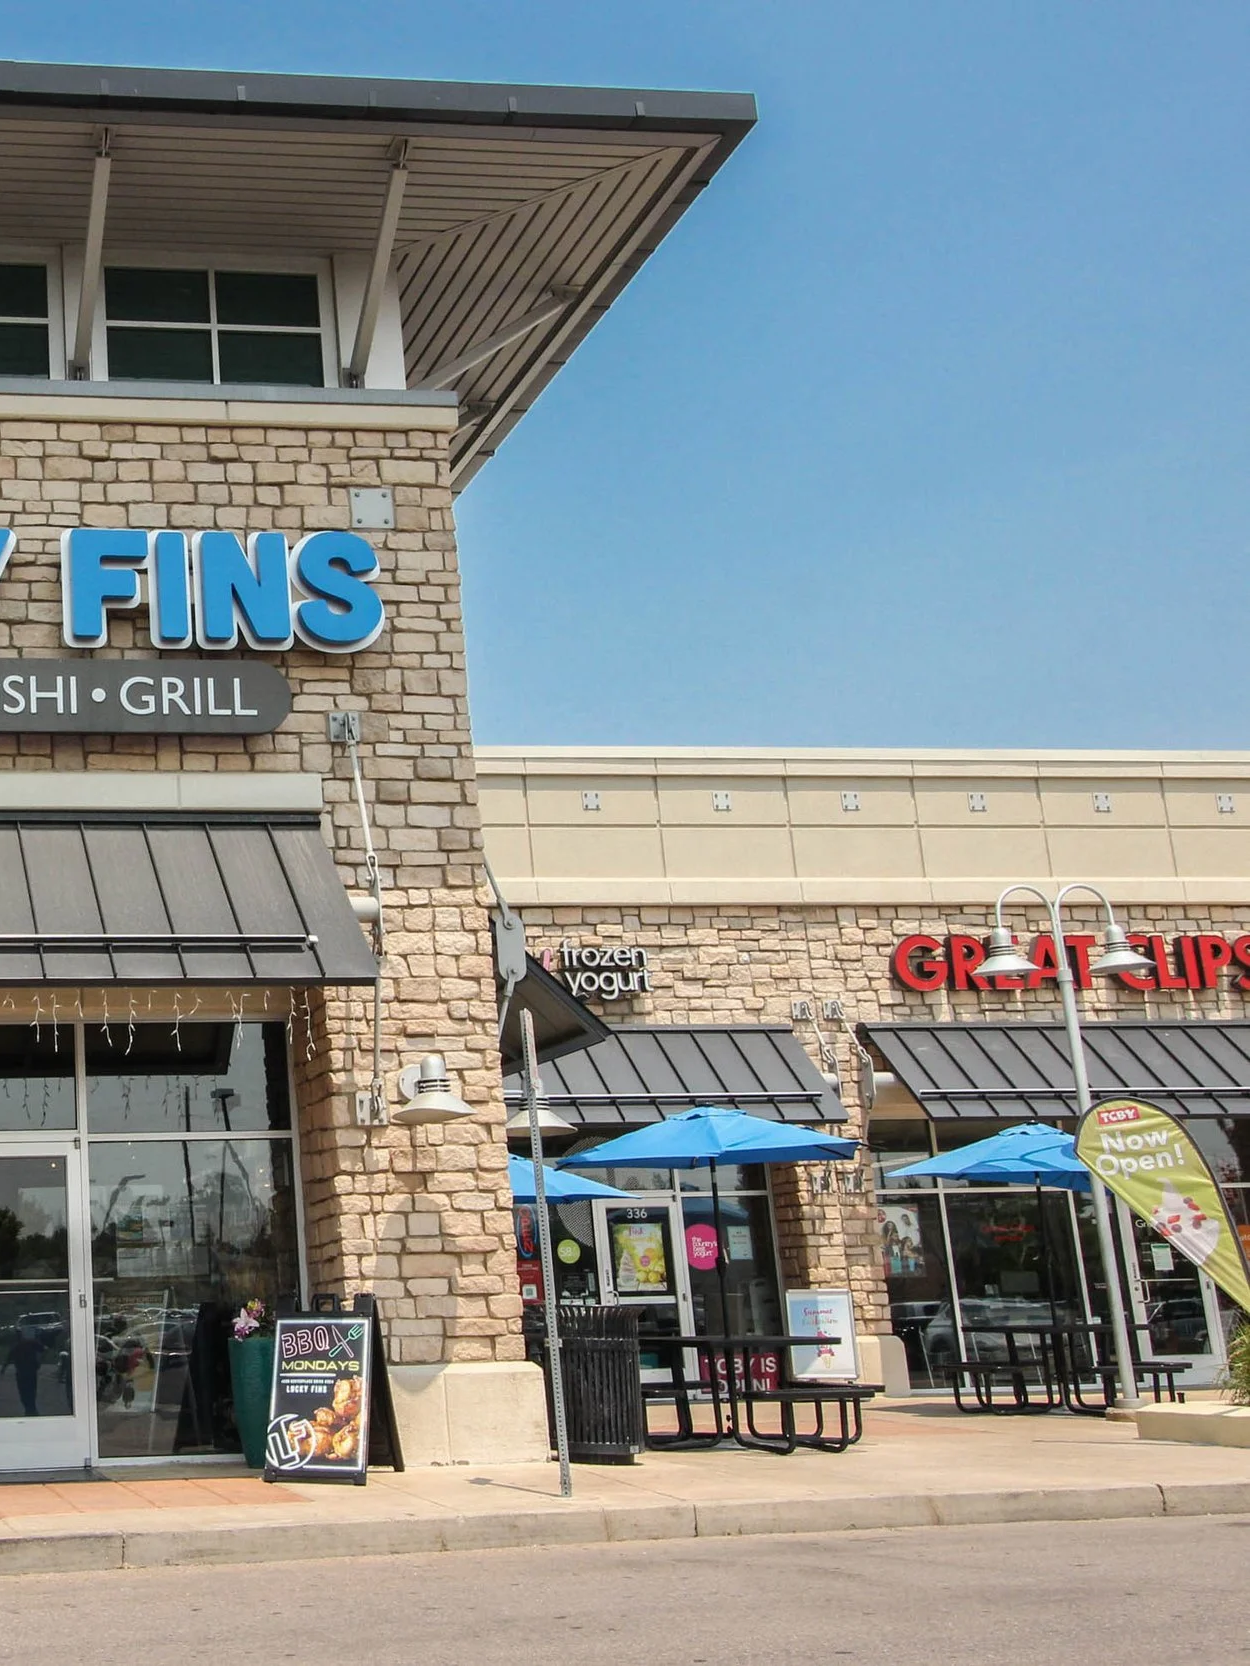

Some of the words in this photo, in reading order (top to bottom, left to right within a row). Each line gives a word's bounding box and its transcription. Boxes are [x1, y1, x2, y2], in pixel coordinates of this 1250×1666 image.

[61, 528, 384, 654] FINS
[119, 676, 258, 716] GRILL
[560, 938, 648, 967] frozen
[564, 967, 654, 1000] yogurt
[1100, 1109, 1136, 1123] TCBY
[1100, 1130, 1168, 1154] Now
[1096, 1144, 1184, 1180] Open!
[626, 1208, 648, 1219] 336
[281, 1325, 330, 1358] BBQ
[282, 1360, 360, 1371] MONDAYS
[761, 1357, 777, 1373] IS
[286, 1385, 308, 1393] LUCKY
[310, 1385, 327, 1393] FINS
